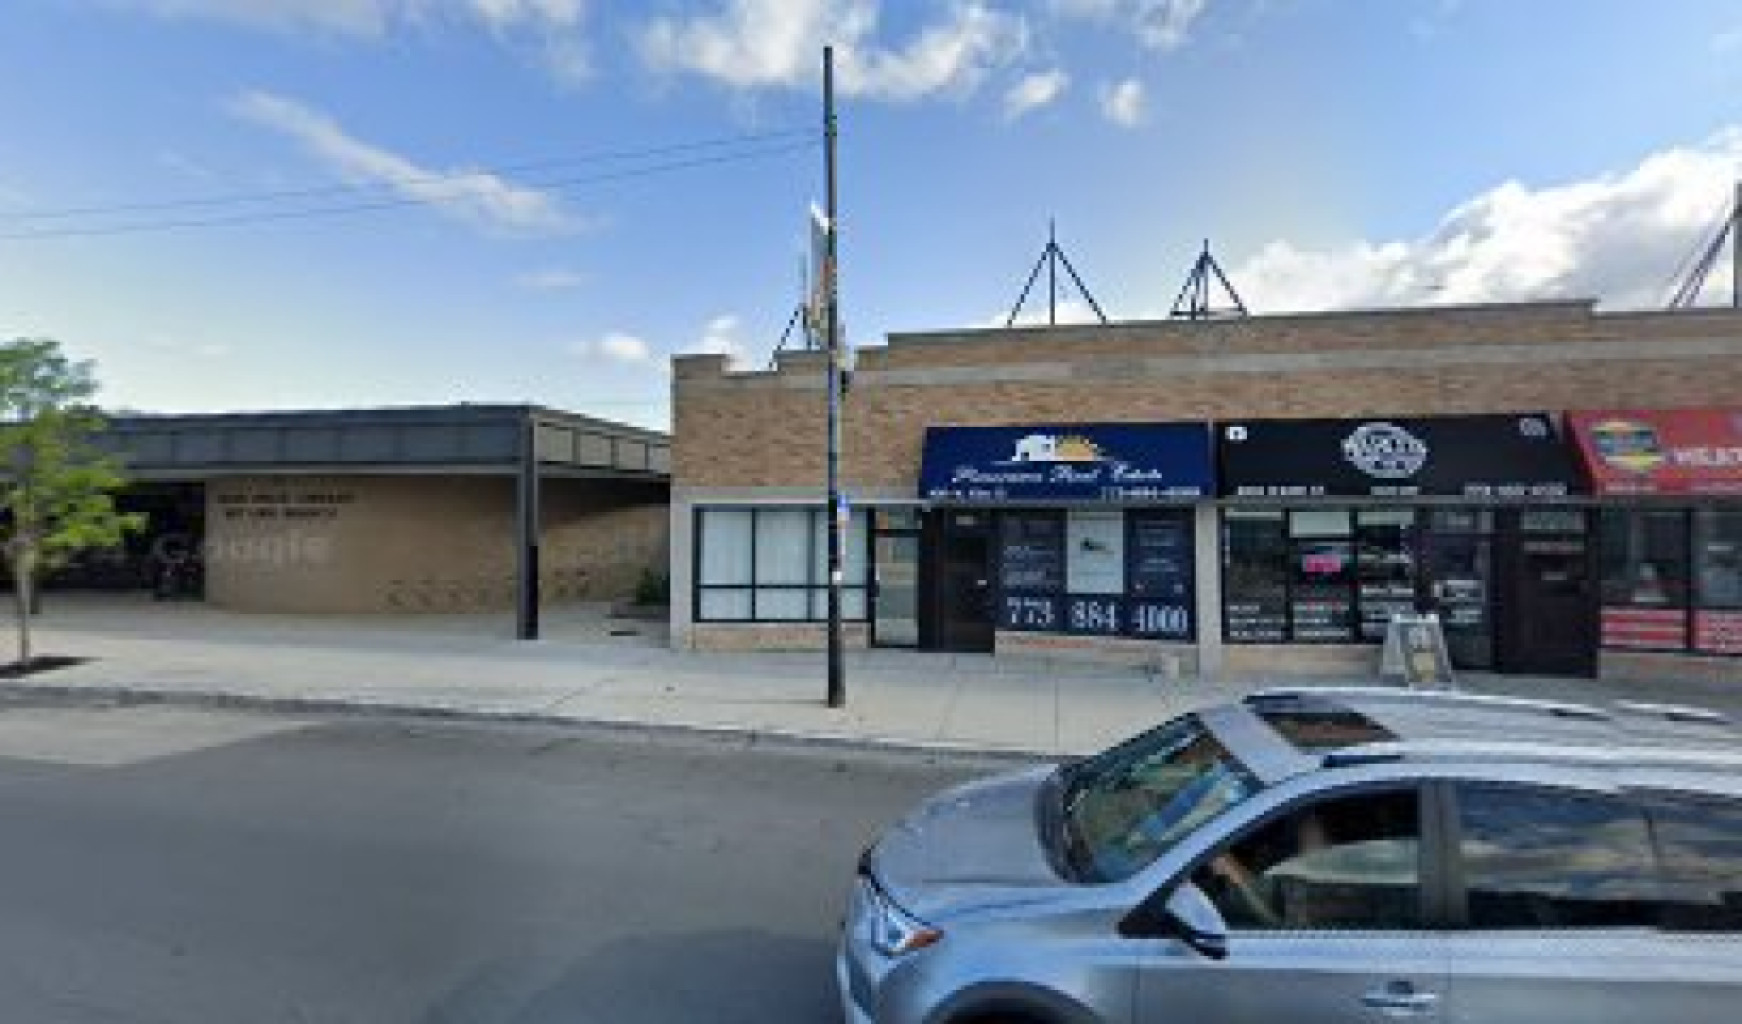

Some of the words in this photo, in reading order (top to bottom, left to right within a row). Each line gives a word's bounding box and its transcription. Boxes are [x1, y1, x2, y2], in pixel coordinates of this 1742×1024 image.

[1006, 597, 1056, 625] 773
[1071, 601, 1118, 629] 884
[1132, 605, 1189, 634] 4000
